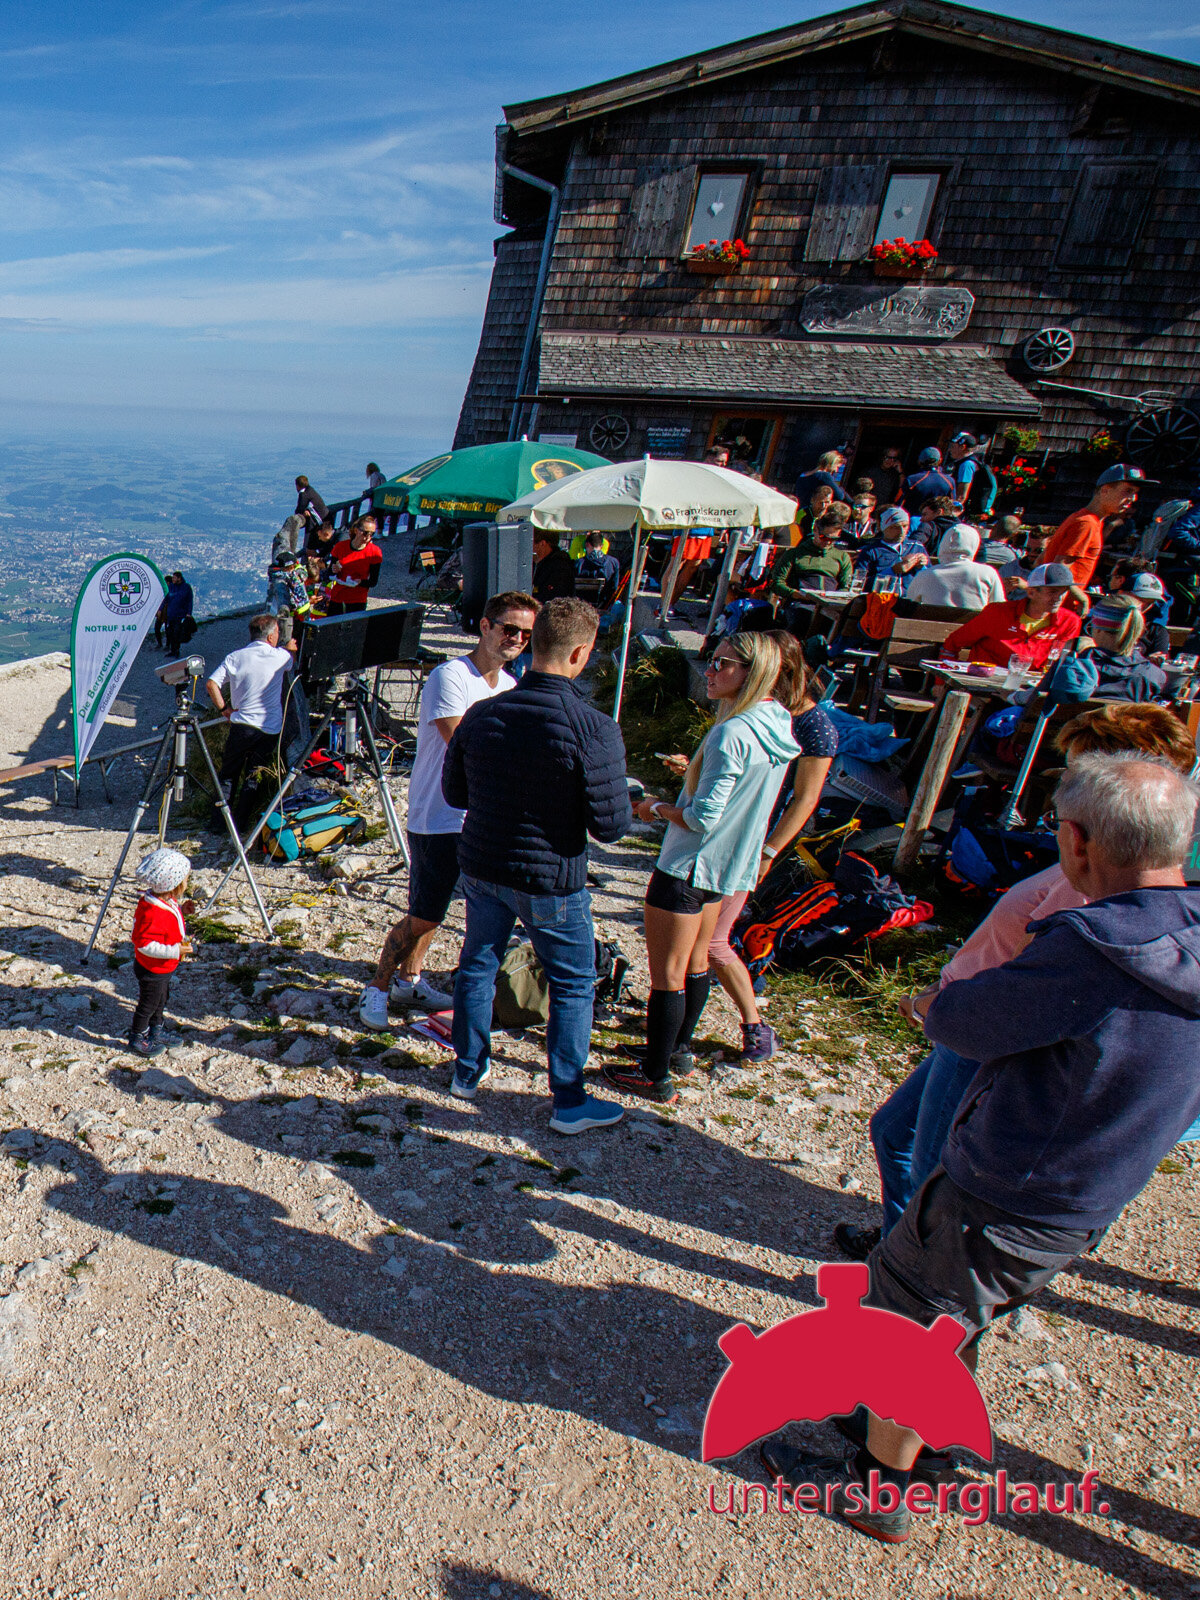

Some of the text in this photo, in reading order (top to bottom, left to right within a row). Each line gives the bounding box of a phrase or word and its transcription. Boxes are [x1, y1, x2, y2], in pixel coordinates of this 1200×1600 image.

[101, 563, 150, 591] BERGRETTUNGSDIENST
[105, 598, 145, 614] ÖSTERREICH
[84, 624, 137, 633] NOTRUF 140
[78, 639, 121, 719] Die Bergrettung
